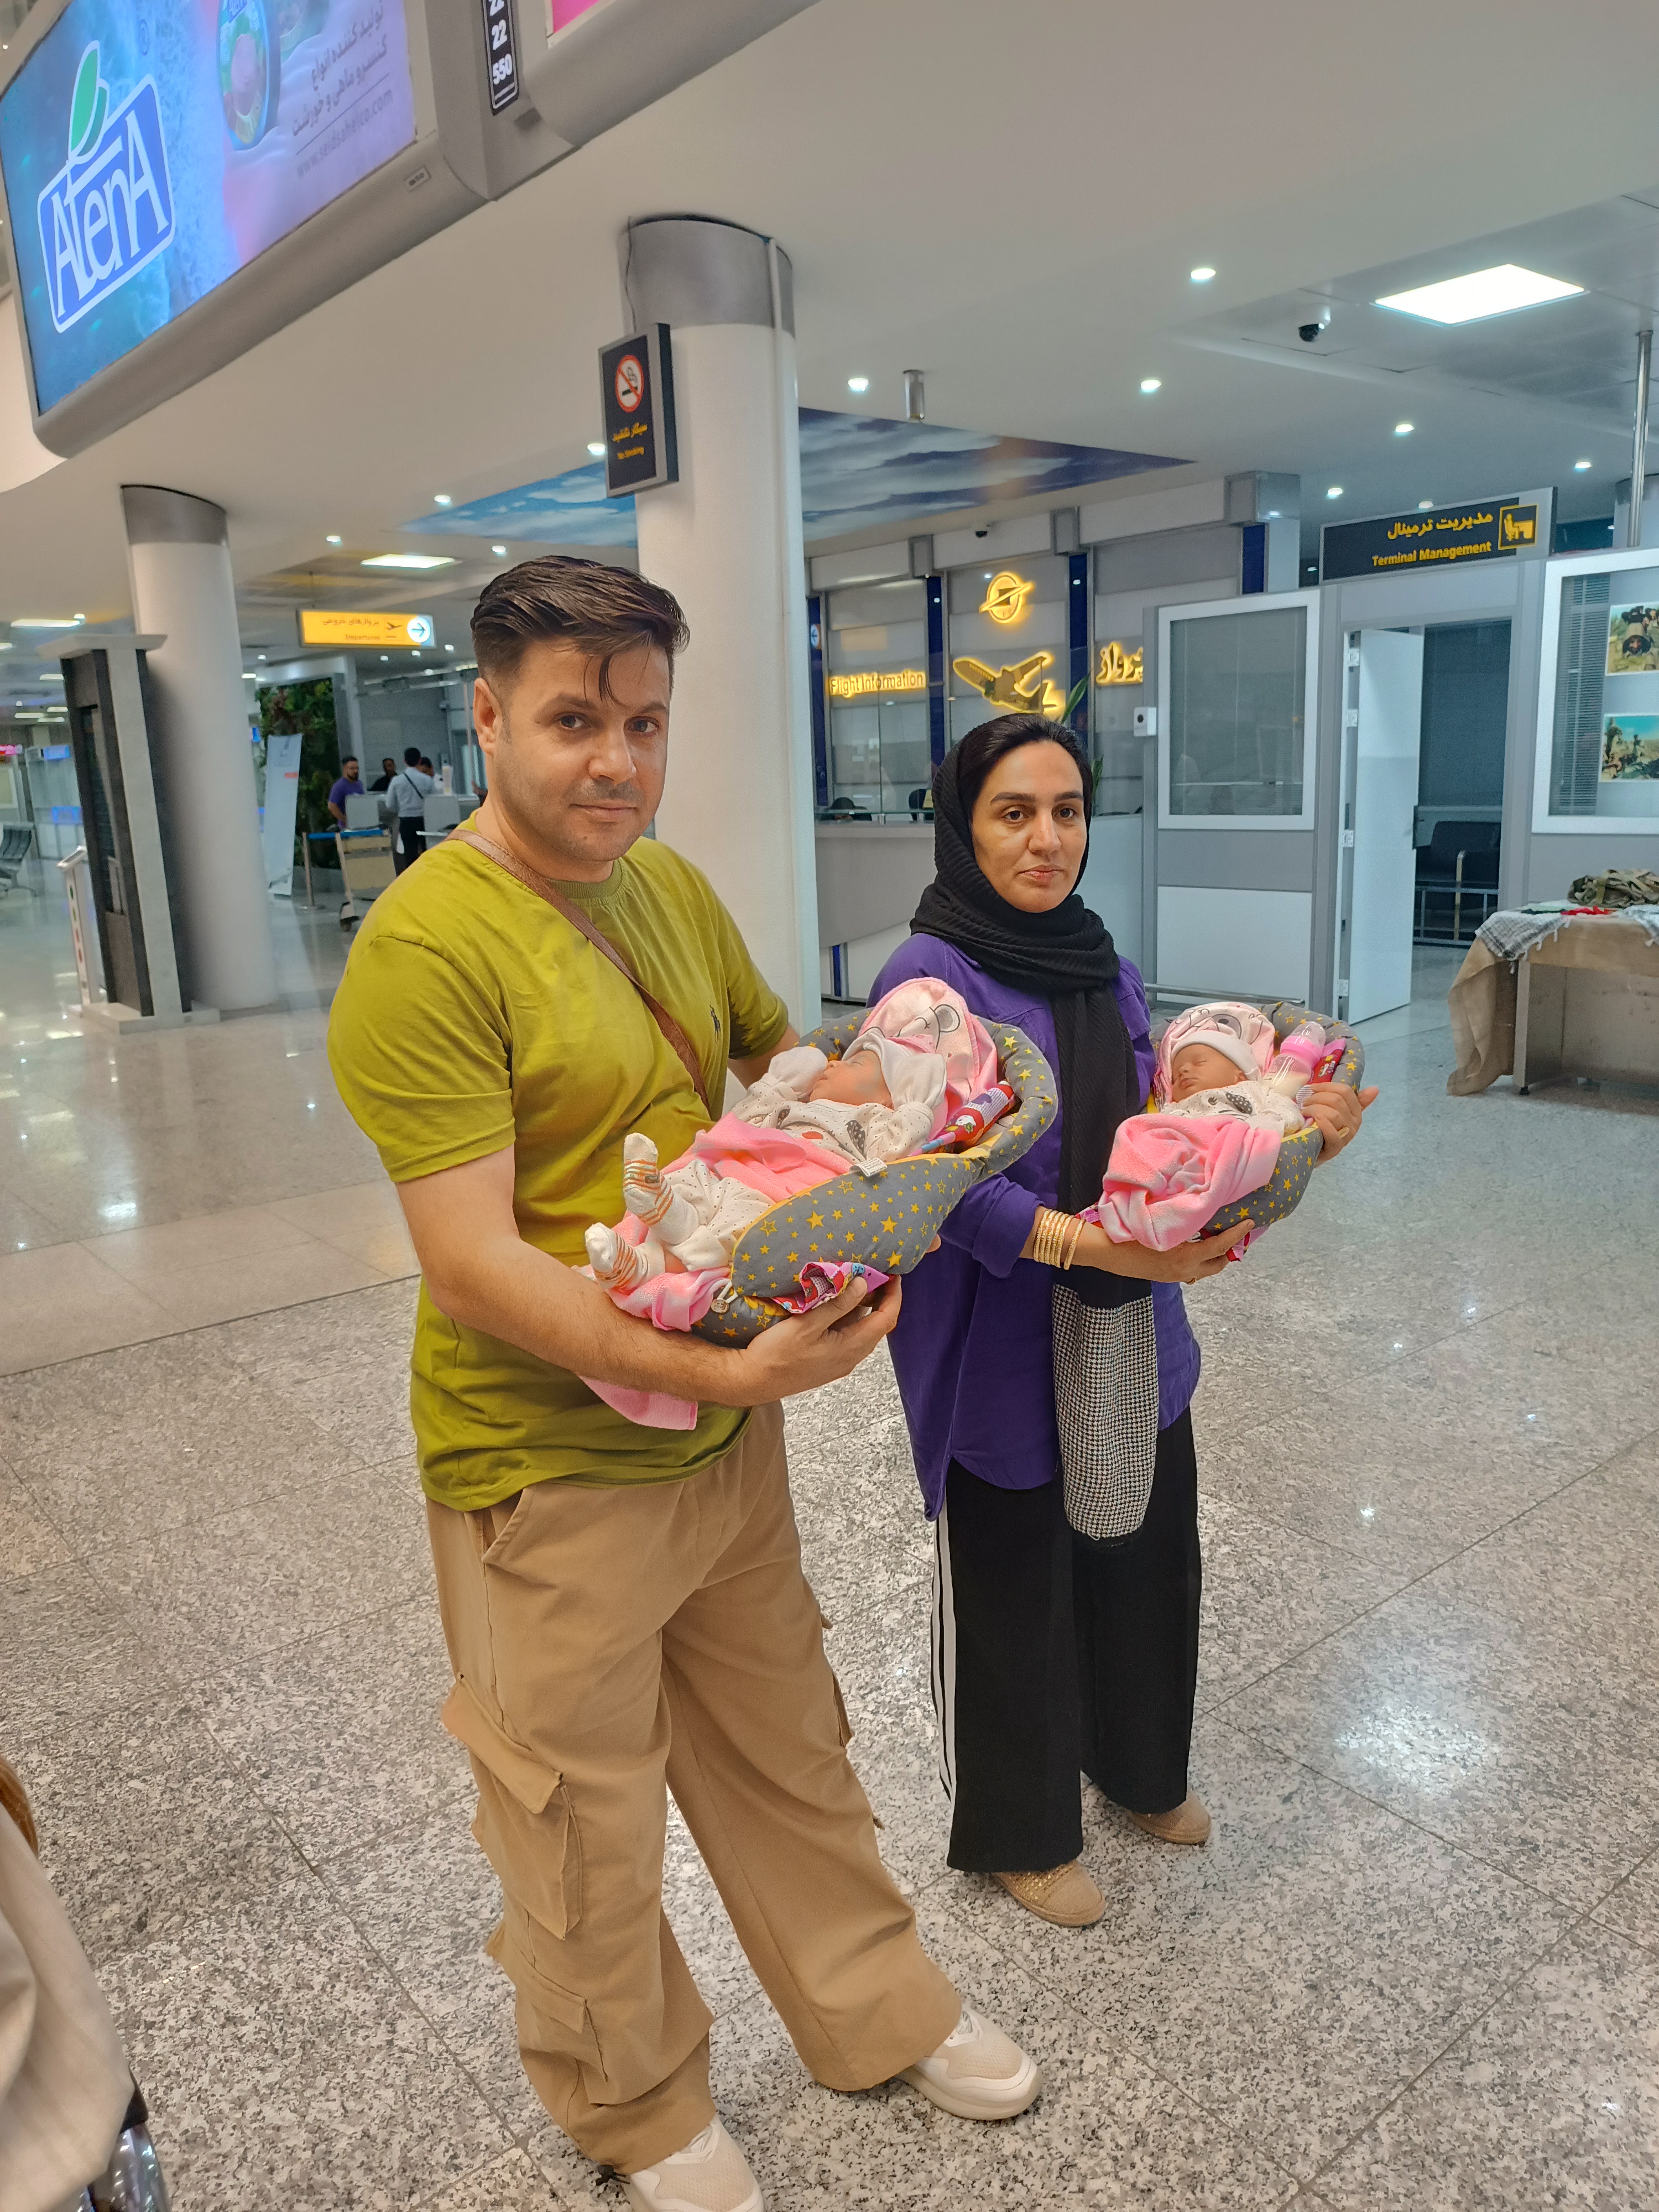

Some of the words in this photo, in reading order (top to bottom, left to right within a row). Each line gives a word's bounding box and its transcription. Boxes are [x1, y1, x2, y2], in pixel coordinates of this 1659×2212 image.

[492, 19, 508, 50] 22
[492, 53, 513, 85] 550
[1387, 519, 1434, 540] ترمینال
[1436, 512, 1493, 531] مدیریت
[1372, 550, 1417, 566] Terminal
[1419, 541, 1492, 560] Management
[831, 675, 859, 696] Flight
[862, 671, 924, 691] Information
